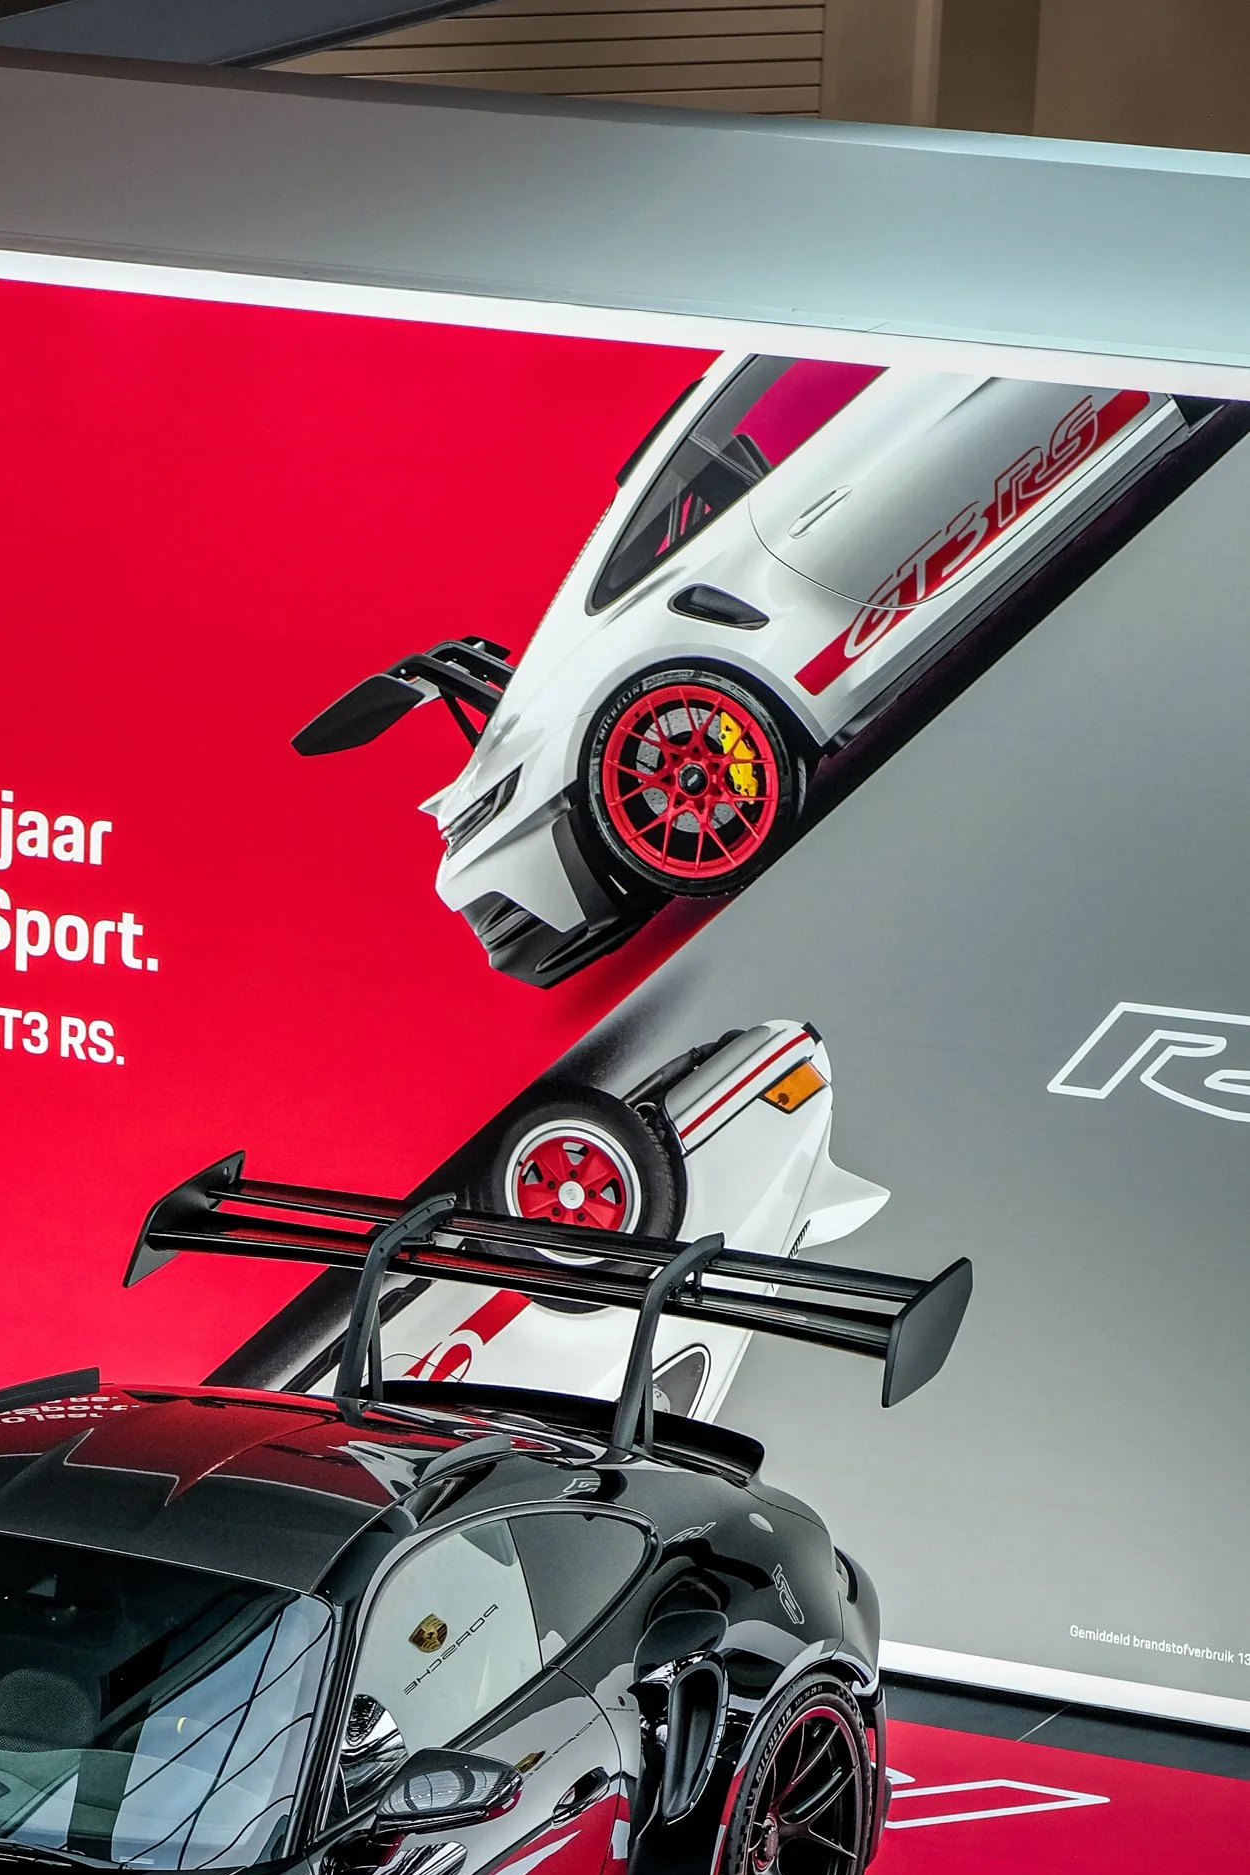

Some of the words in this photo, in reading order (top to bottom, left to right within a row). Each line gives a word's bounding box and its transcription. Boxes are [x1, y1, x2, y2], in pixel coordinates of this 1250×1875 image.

[844, 500, 988, 659] GT3
[994, 394, 1099, 528] RS
[60, 1015, 125, 1066] RS.
[1046, 1001, 1250, 1123] R
[1069, 1624, 1130, 1646] Gemiddeld
[1133, 1635, 1234, 1663] brandstofverbruik
[755, 1706, 792, 1782] MICHELIN
